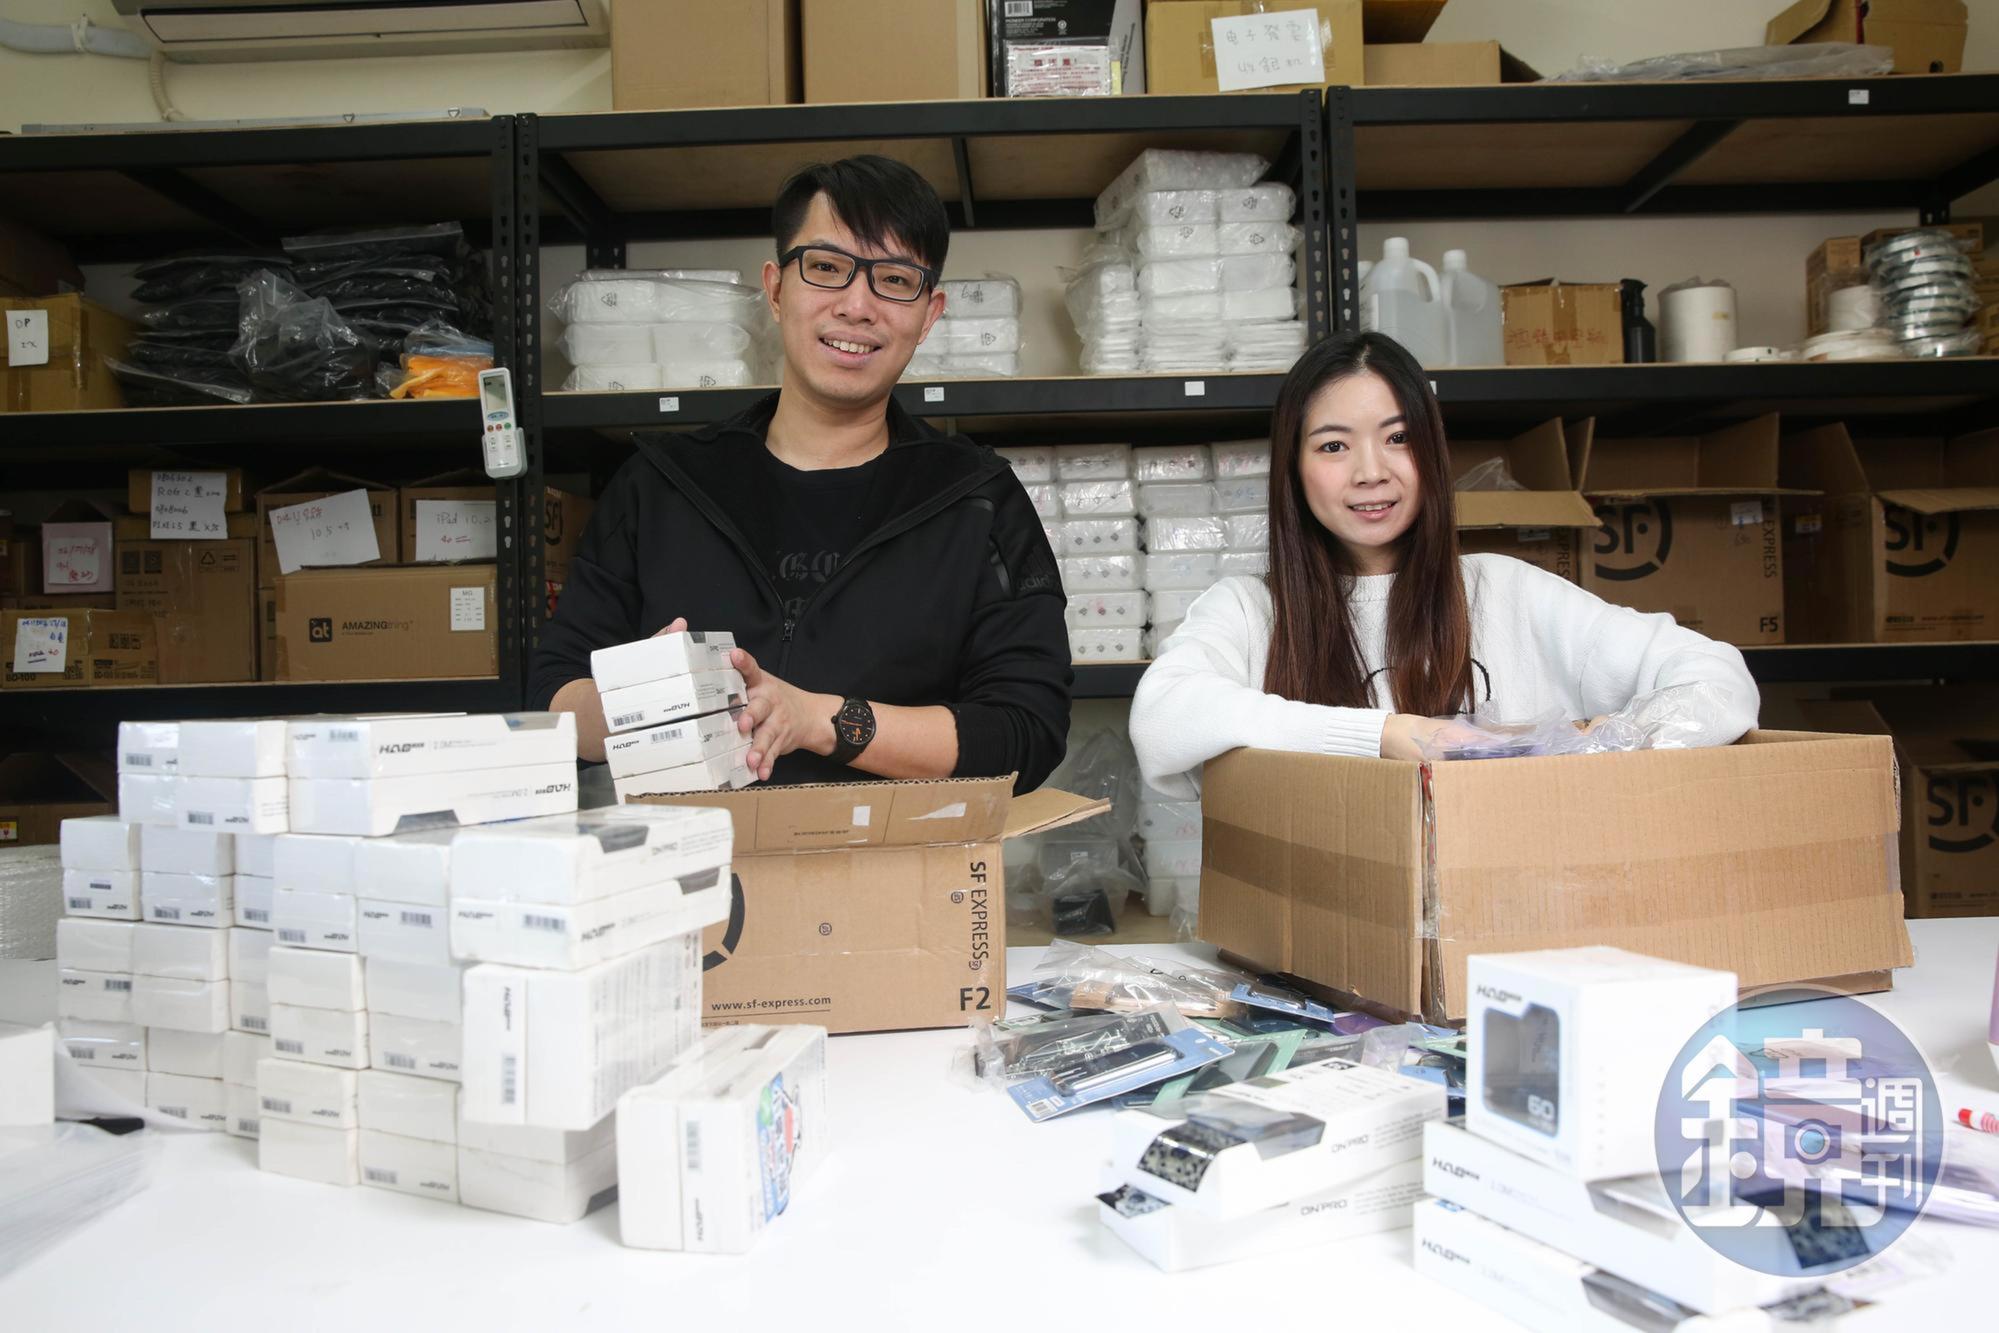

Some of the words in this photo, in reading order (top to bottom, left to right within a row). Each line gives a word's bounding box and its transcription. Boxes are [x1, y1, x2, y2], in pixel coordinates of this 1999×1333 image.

[1763, 519, 1776, 578] EXPRESS
[1760, 617, 1778, 633] F5
[970, 861, 986, 884] SF
[971, 889, 988, 959] EXPRESS
[711, 996, 831, 1012] www.sf-express.com
[959, 986, 991, 1011] F2
